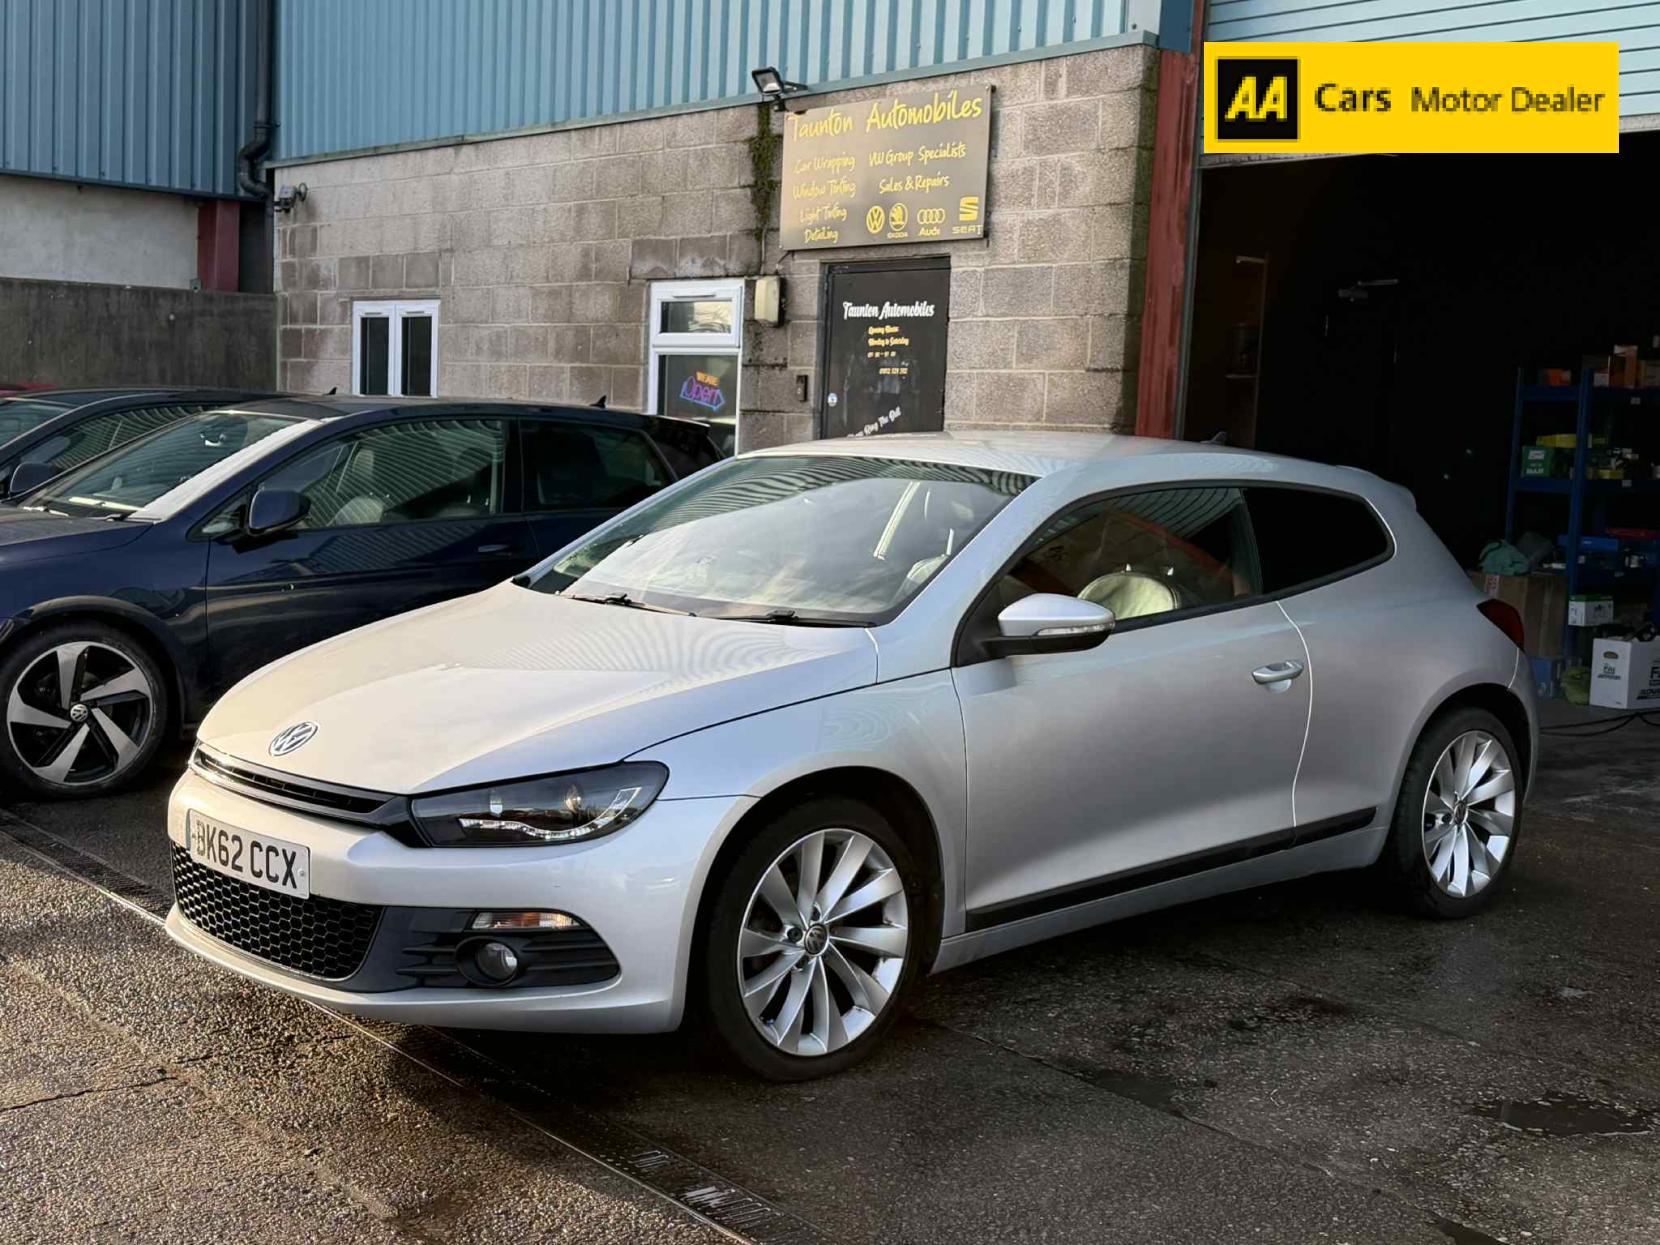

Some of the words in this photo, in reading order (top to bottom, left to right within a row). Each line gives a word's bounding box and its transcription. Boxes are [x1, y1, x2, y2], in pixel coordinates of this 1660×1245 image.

[787, 108, 853, 142] Taunton
[866, 89, 984, 133] Automobiles
[794, 159, 812, 174] Car
[814, 152, 856, 175] Wrapping
[869, 152, 885, 167] VW
[886, 149, 914, 167] Group
[918, 141, 966, 164] Specialists
[793, 181, 826, 200] Window
[826, 176, 856, 198] Tinting
[879, 179, 902, 194] Sales
[904, 176, 914, 191] &
[915, 172, 950, 193] Repairs
[800, 206, 822, 226] Light
[805, 226, 839, 244] Detailing
[918, 227, 941, 237] Audi
[952, 224, 983, 236] SEAT
[843, 301, 878, 320] Taunton
[879, 301, 935, 320] Automobiles
[688, 376, 718, 405] Open
[196, 819, 243, 873] BK62
[250, 840, 297, 889] CCX
